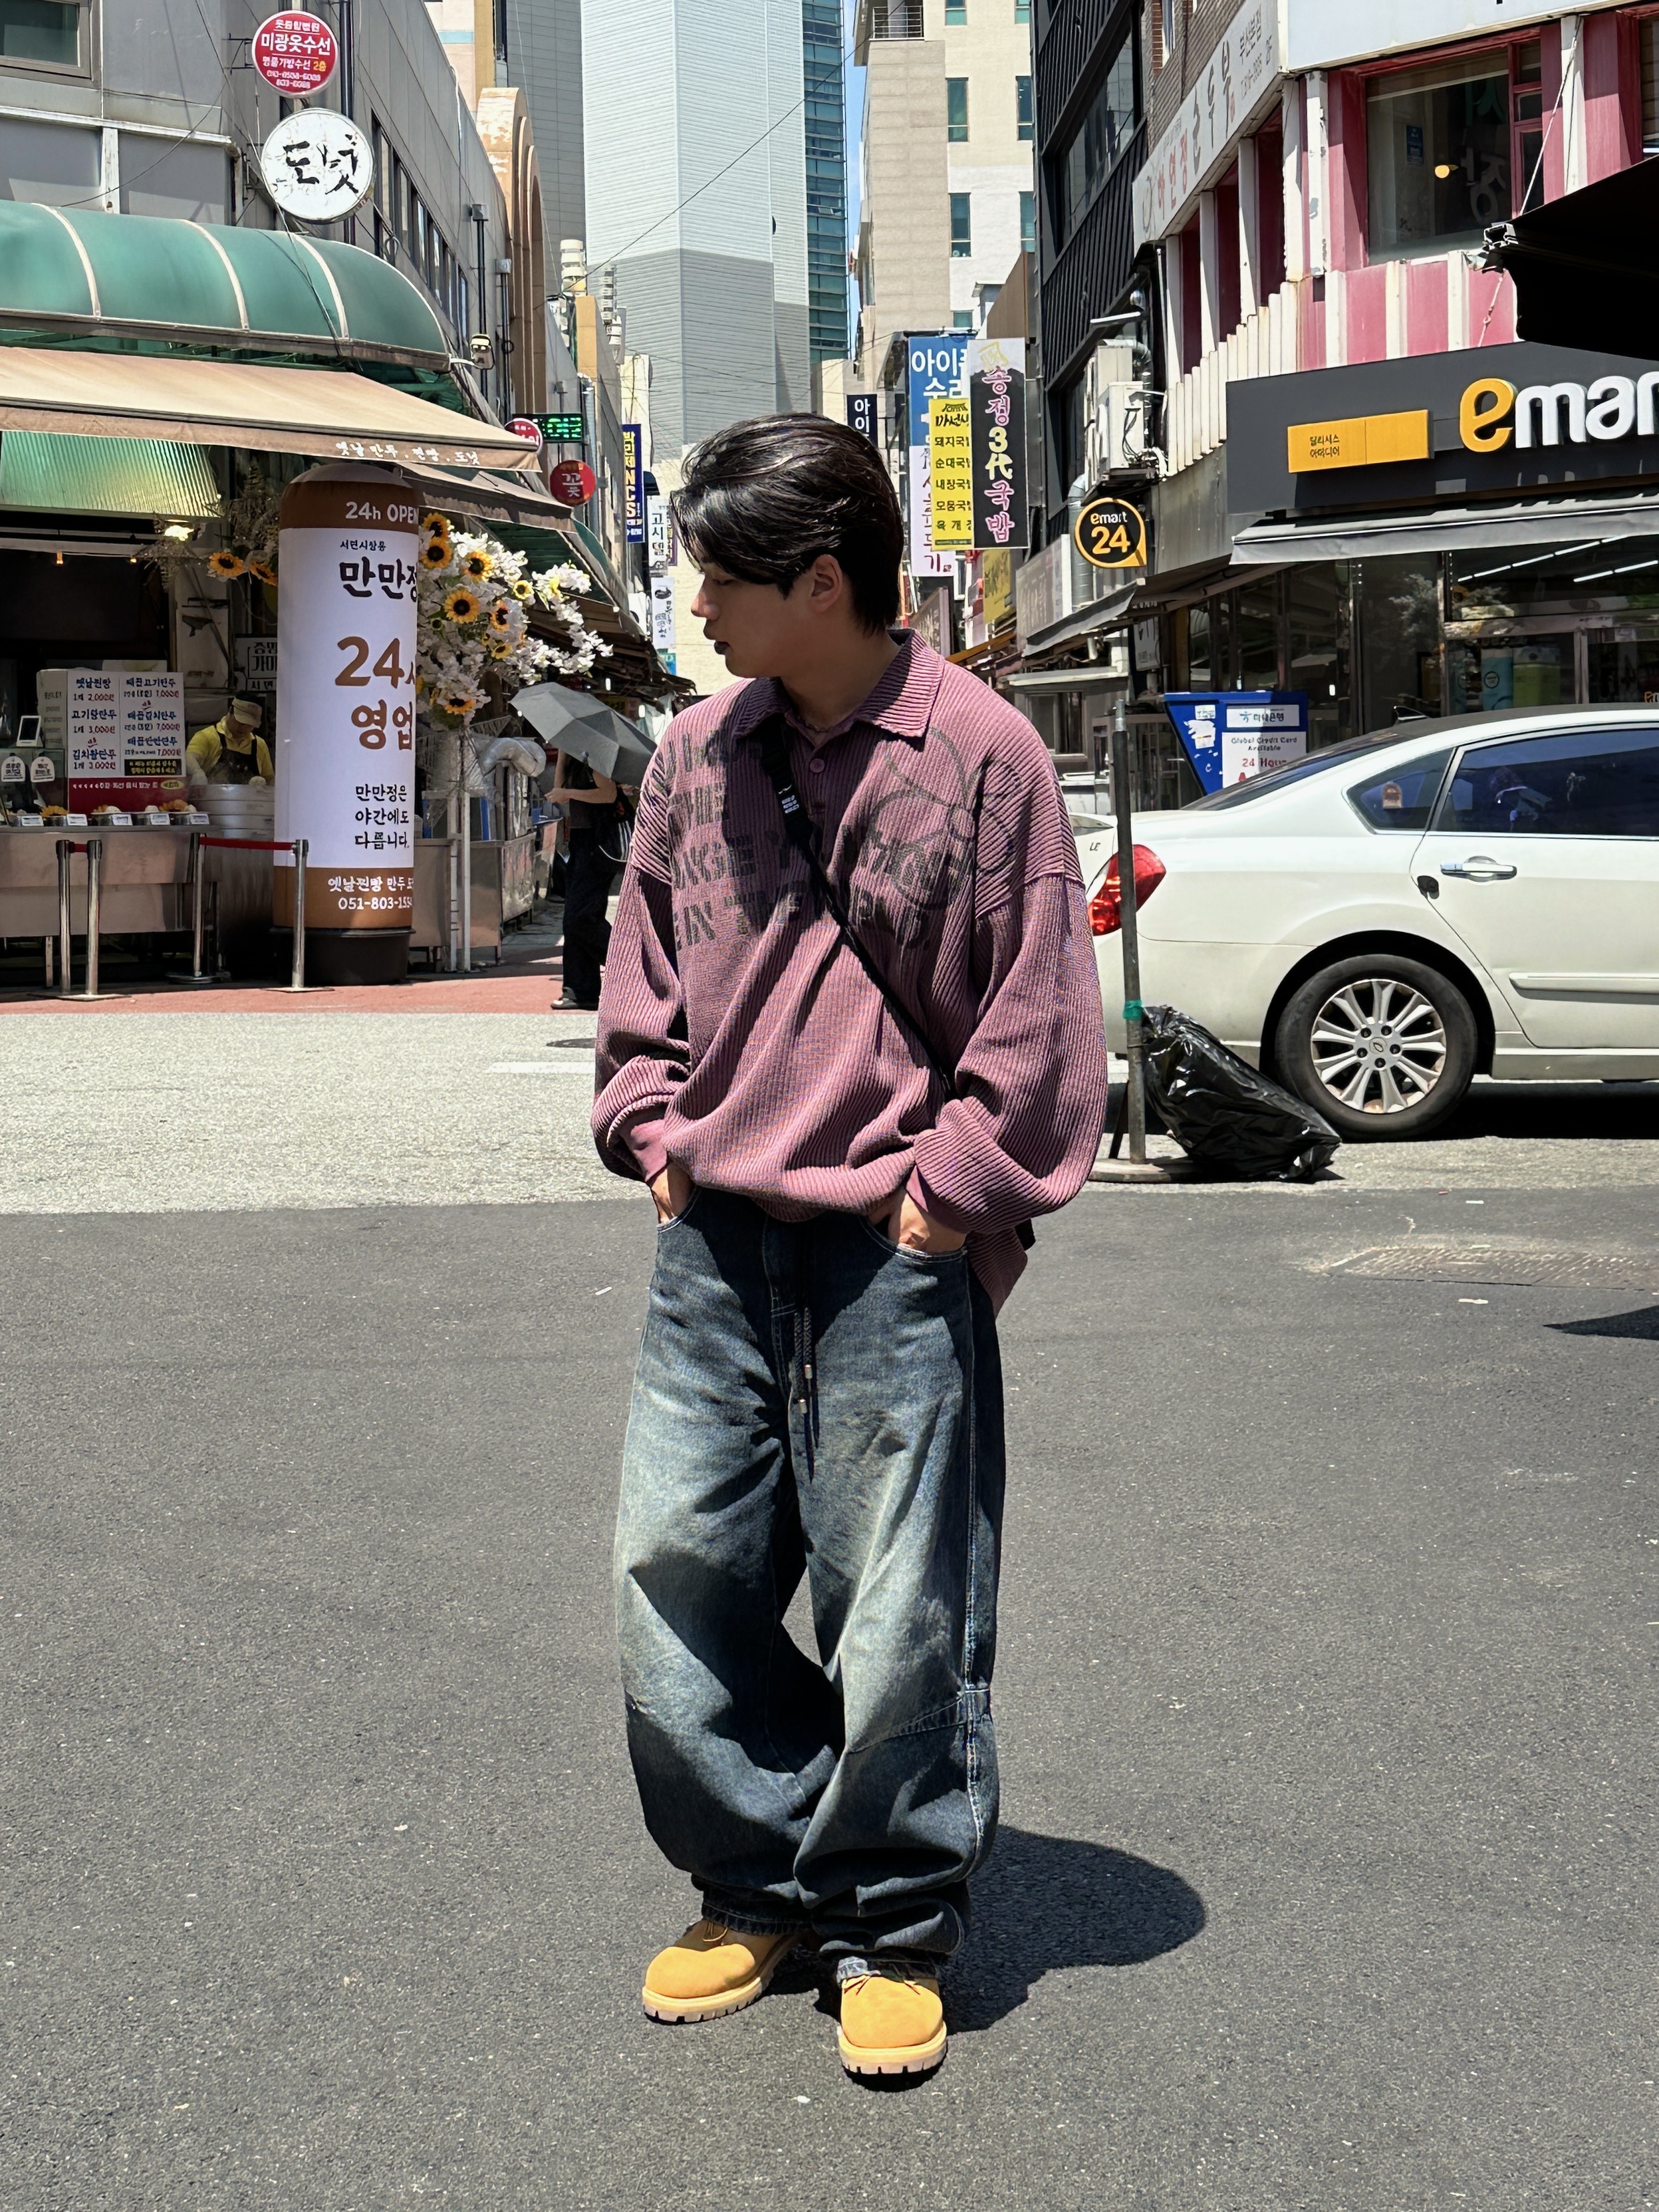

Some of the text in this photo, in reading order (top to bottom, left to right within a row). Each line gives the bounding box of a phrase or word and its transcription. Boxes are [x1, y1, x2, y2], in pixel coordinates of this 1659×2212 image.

[261, 33, 331, 56] 미광옷수선
[854, 398, 871, 437] 아이
[1459, 371, 1659, 453] emar
[335, 441, 364, 458] 옛날
[368, 443, 398, 458] 만두
[454, 450, 481, 466] 도넛
[345, 501, 382, 520] 24h
[1090, 511, 1128, 525] emart
[1091, 524, 1131, 555] 24
[351, 699, 412, 751] 영업
[355, 783, 408, 802] 만만정은
[354, 807, 410, 825] 야간에도
[327, 876, 384, 893] 옛날찐빵
[386, 876, 406, 892] 만두
